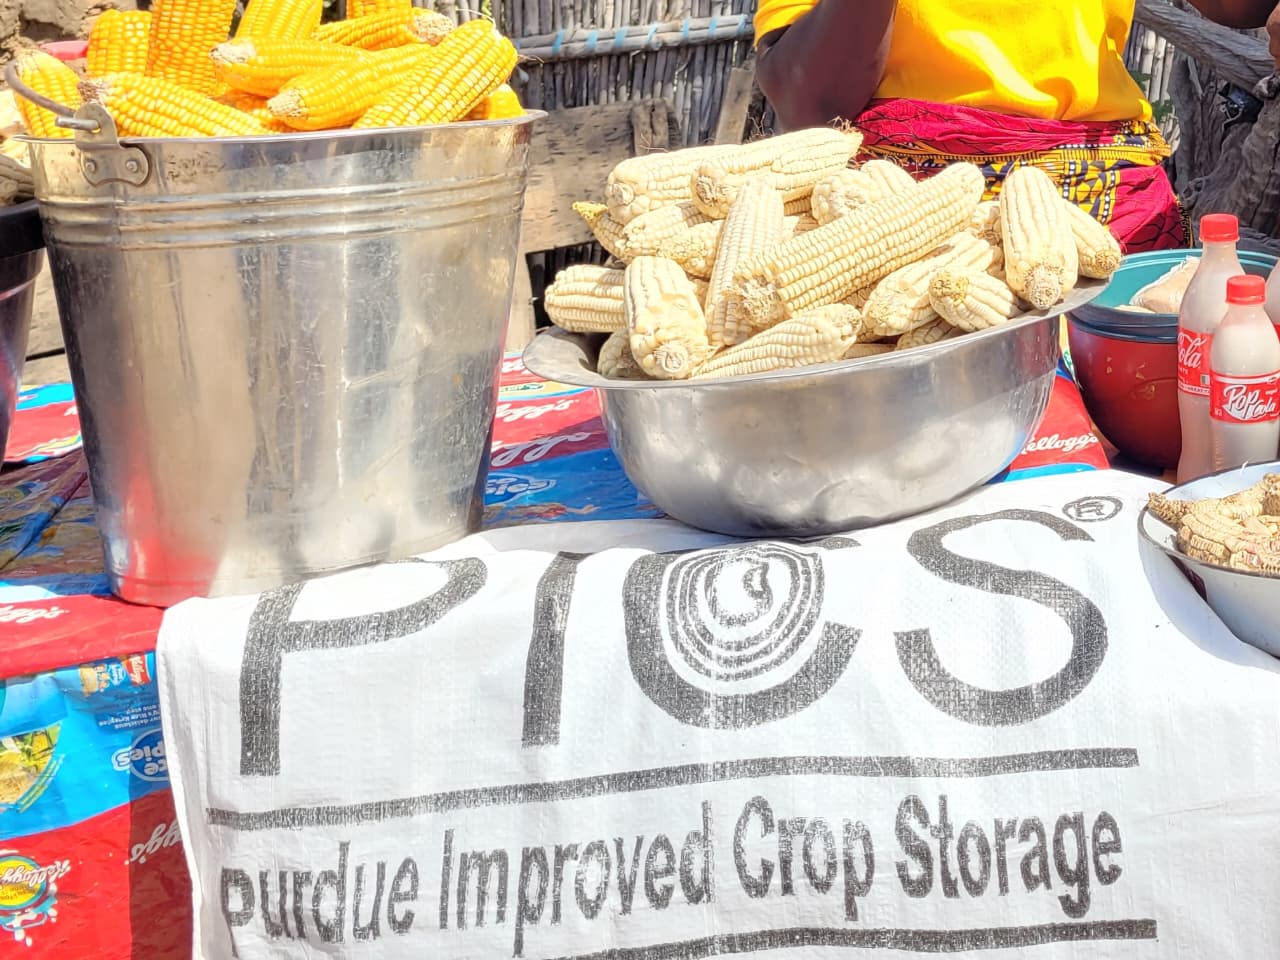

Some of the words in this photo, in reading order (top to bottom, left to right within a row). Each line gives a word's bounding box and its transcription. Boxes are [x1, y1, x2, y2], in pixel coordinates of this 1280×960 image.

[1223, 384, 1260, 419] Pop
[1252, 399, 1276, 418] Cola
[220, 841, 419, 959] Purdue
[439, 800, 713, 958] Improved
[734, 795, 875, 921] Crop
[895, 794, 1123, 918] Storage
